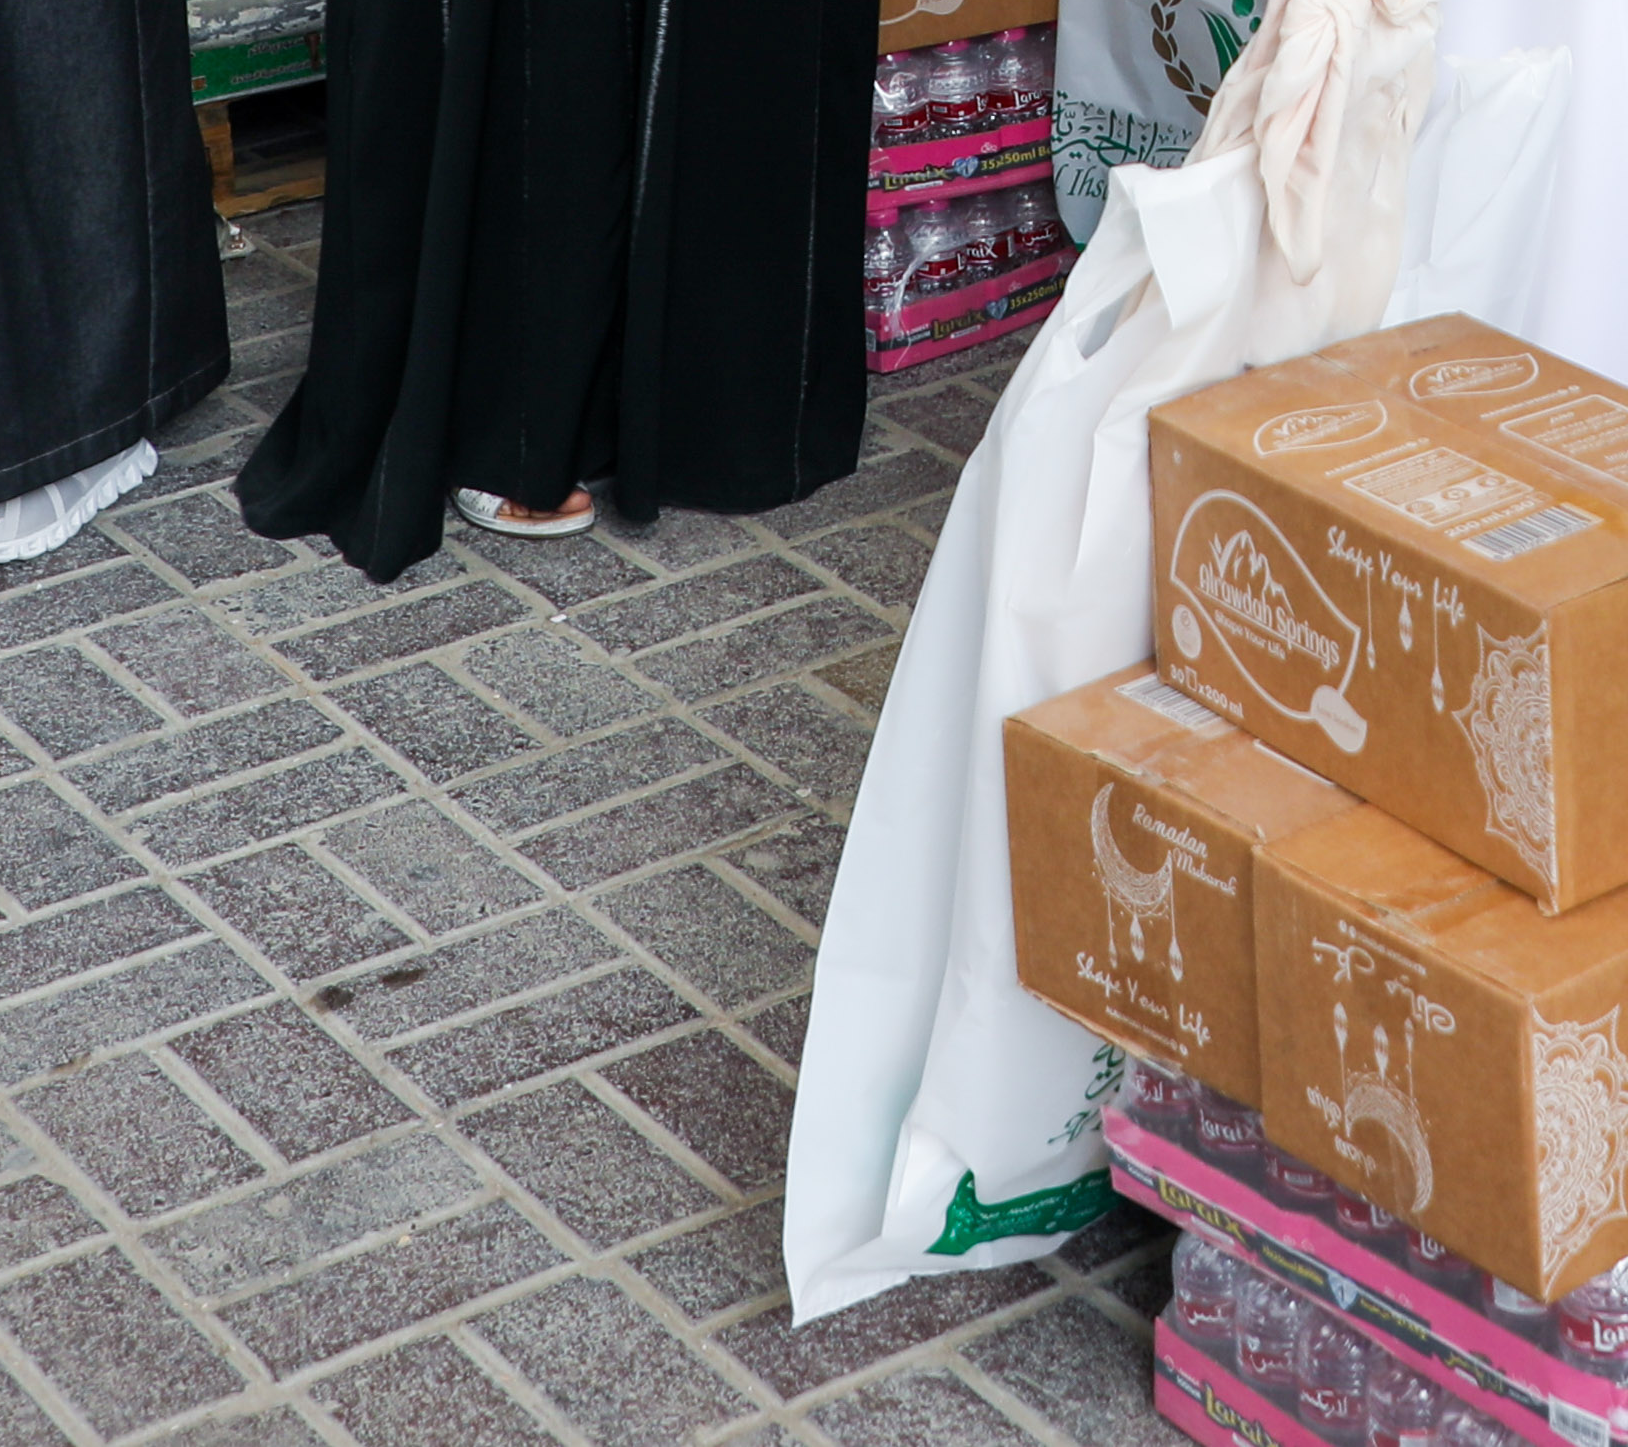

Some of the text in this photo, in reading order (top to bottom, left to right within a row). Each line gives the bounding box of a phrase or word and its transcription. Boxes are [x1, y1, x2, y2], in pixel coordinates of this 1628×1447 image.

[1066, 165, 1107, 201] Ihs
[1327, 526, 1465, 627] Shape Your Life
[1199, 561, 1340, 672] Alrawdah Springs
[1267, 639, 1286, 660] Life
[1132, 803, 1207, 859] Ramadan
[1174, 849, 1237, 896] Mubarak
[1076, 952, 1211, 1046] Shape Your Life
